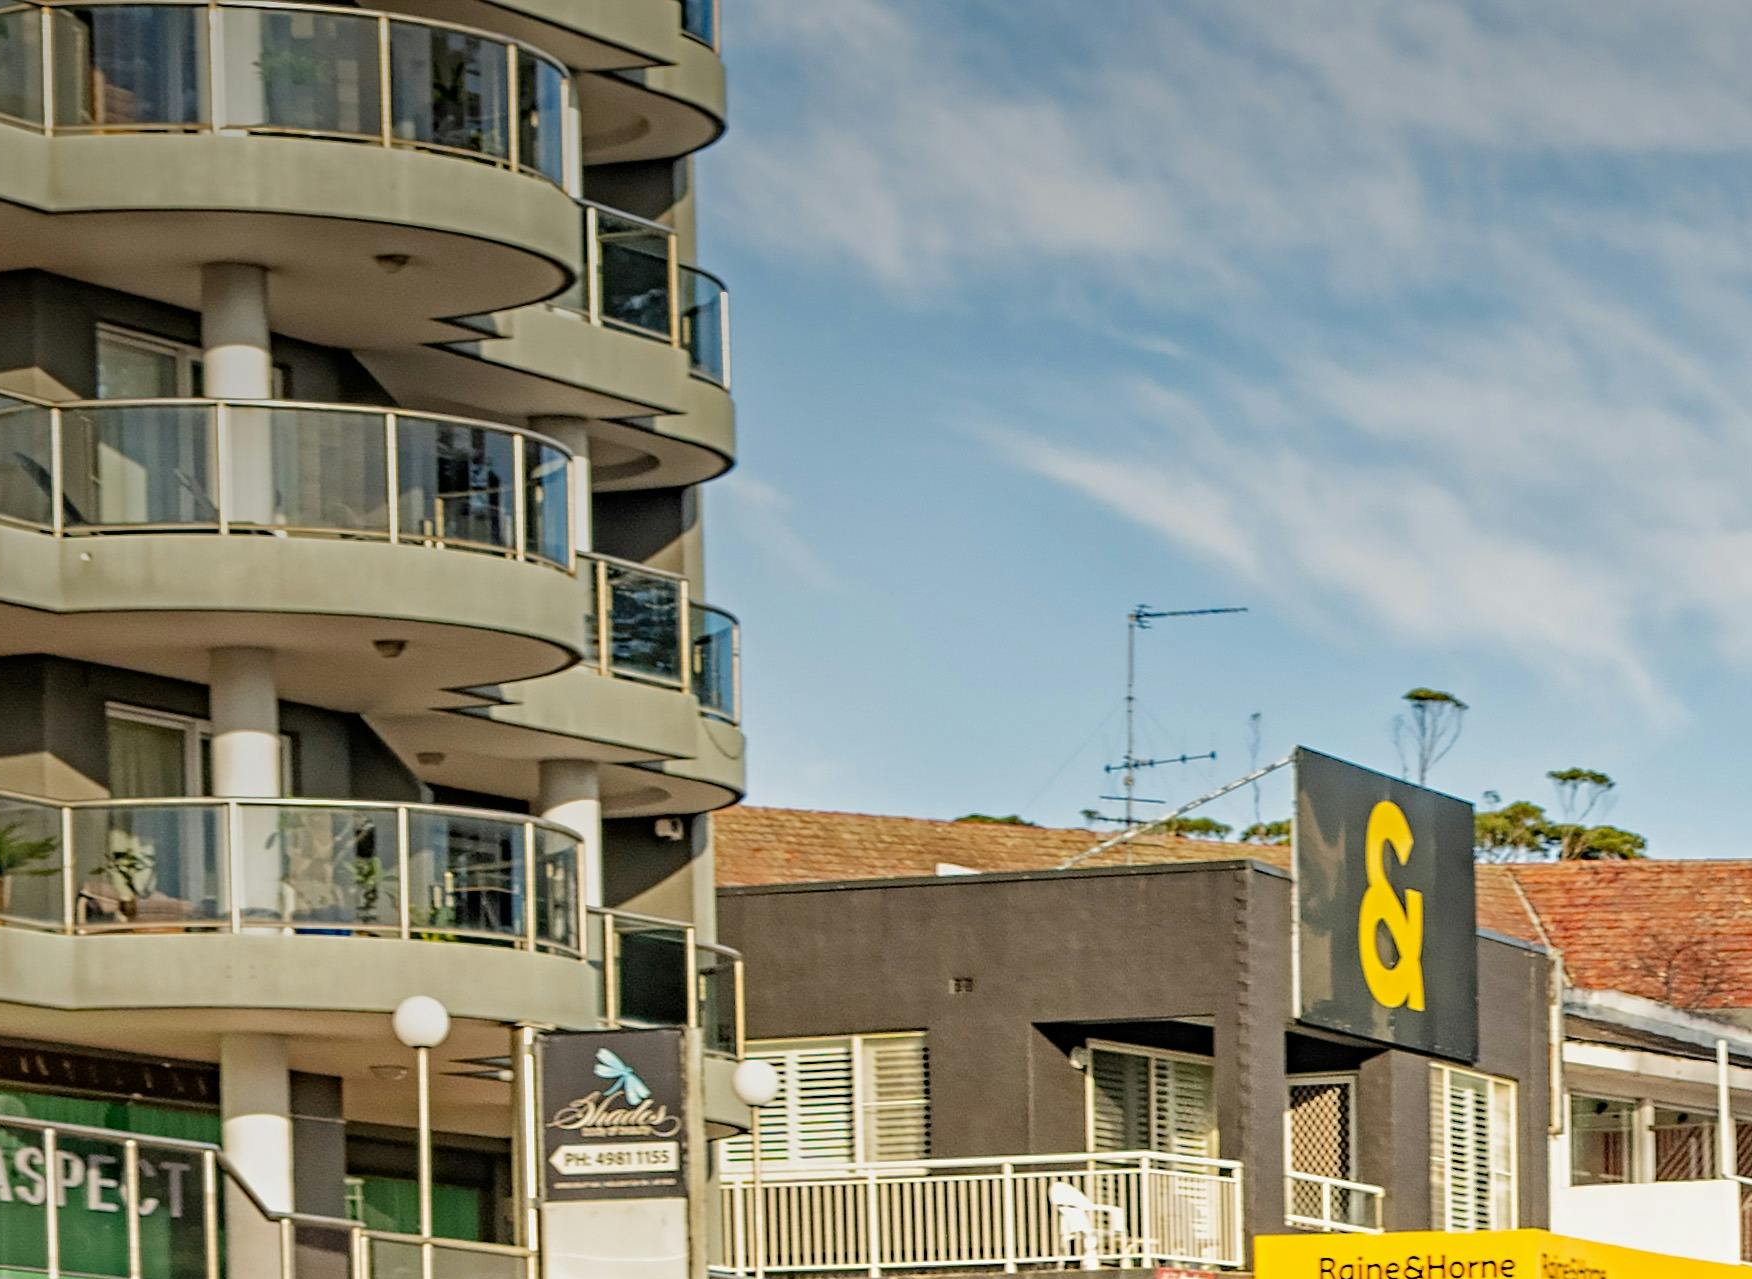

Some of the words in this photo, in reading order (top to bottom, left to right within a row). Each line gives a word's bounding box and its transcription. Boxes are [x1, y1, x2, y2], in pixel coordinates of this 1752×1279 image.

[546, 1090, 681, 1138] Shades
[563, 1152, 592, 1167] PH:
[595, 1151, 633, 1166] 4981
[636, 1149, 671, 1165] 1155
